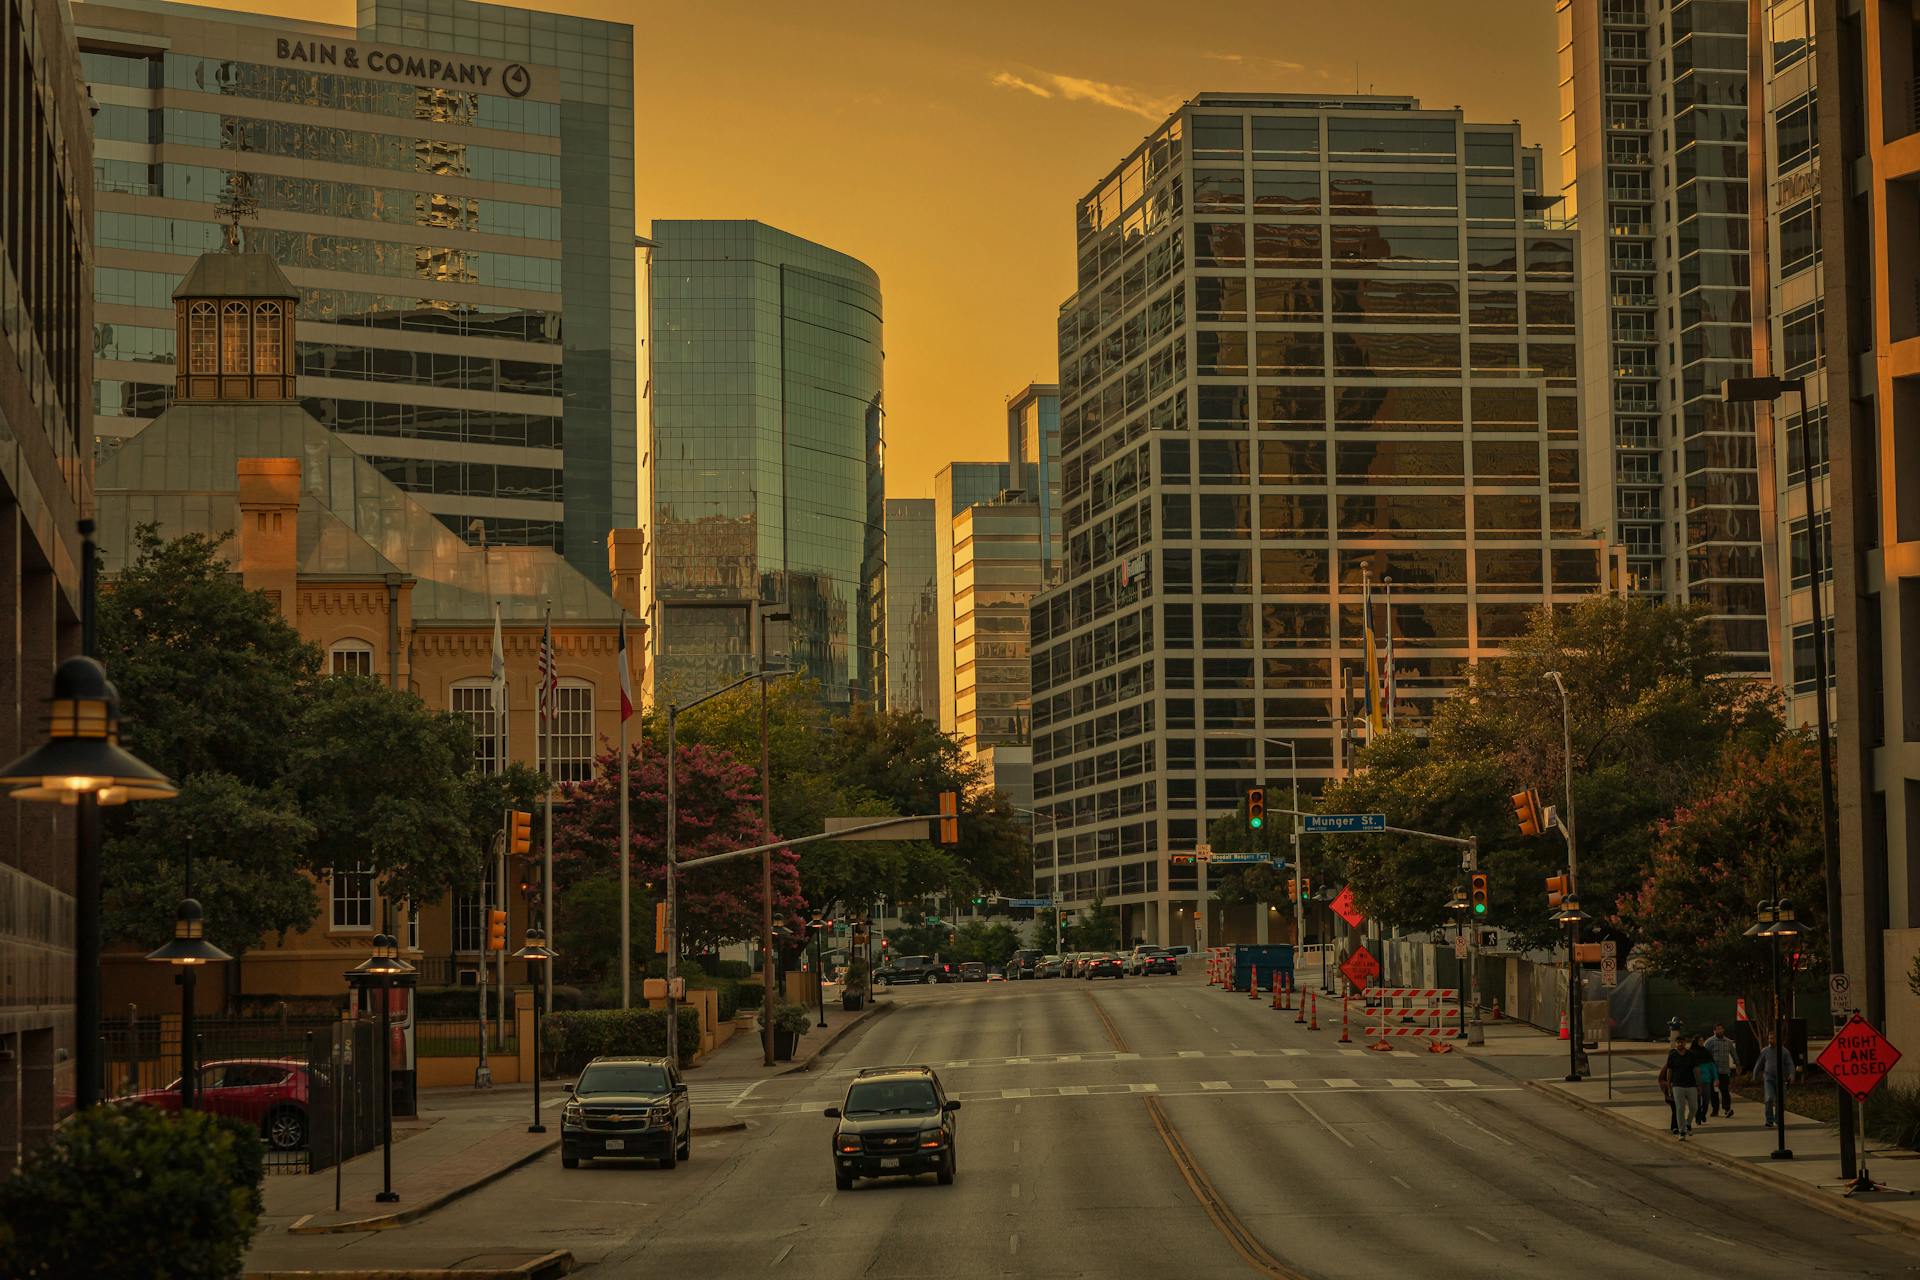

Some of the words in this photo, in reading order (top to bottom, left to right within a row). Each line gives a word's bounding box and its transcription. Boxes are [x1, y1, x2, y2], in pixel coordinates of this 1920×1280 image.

[277, 38, 337, 65] BAIN
[343, 47, 360, 69] &
[367, 50, 492, 86] COMPANY
[1312, 816, 1354, 829] Munger
[1361, 815, 1377, 825] St.
[1838, 1035, 1877, 1049] RIGHT
[1840, 1049, 1877, 1062] LANE
[1833, 1062, 1886, 1076] CLOSED
